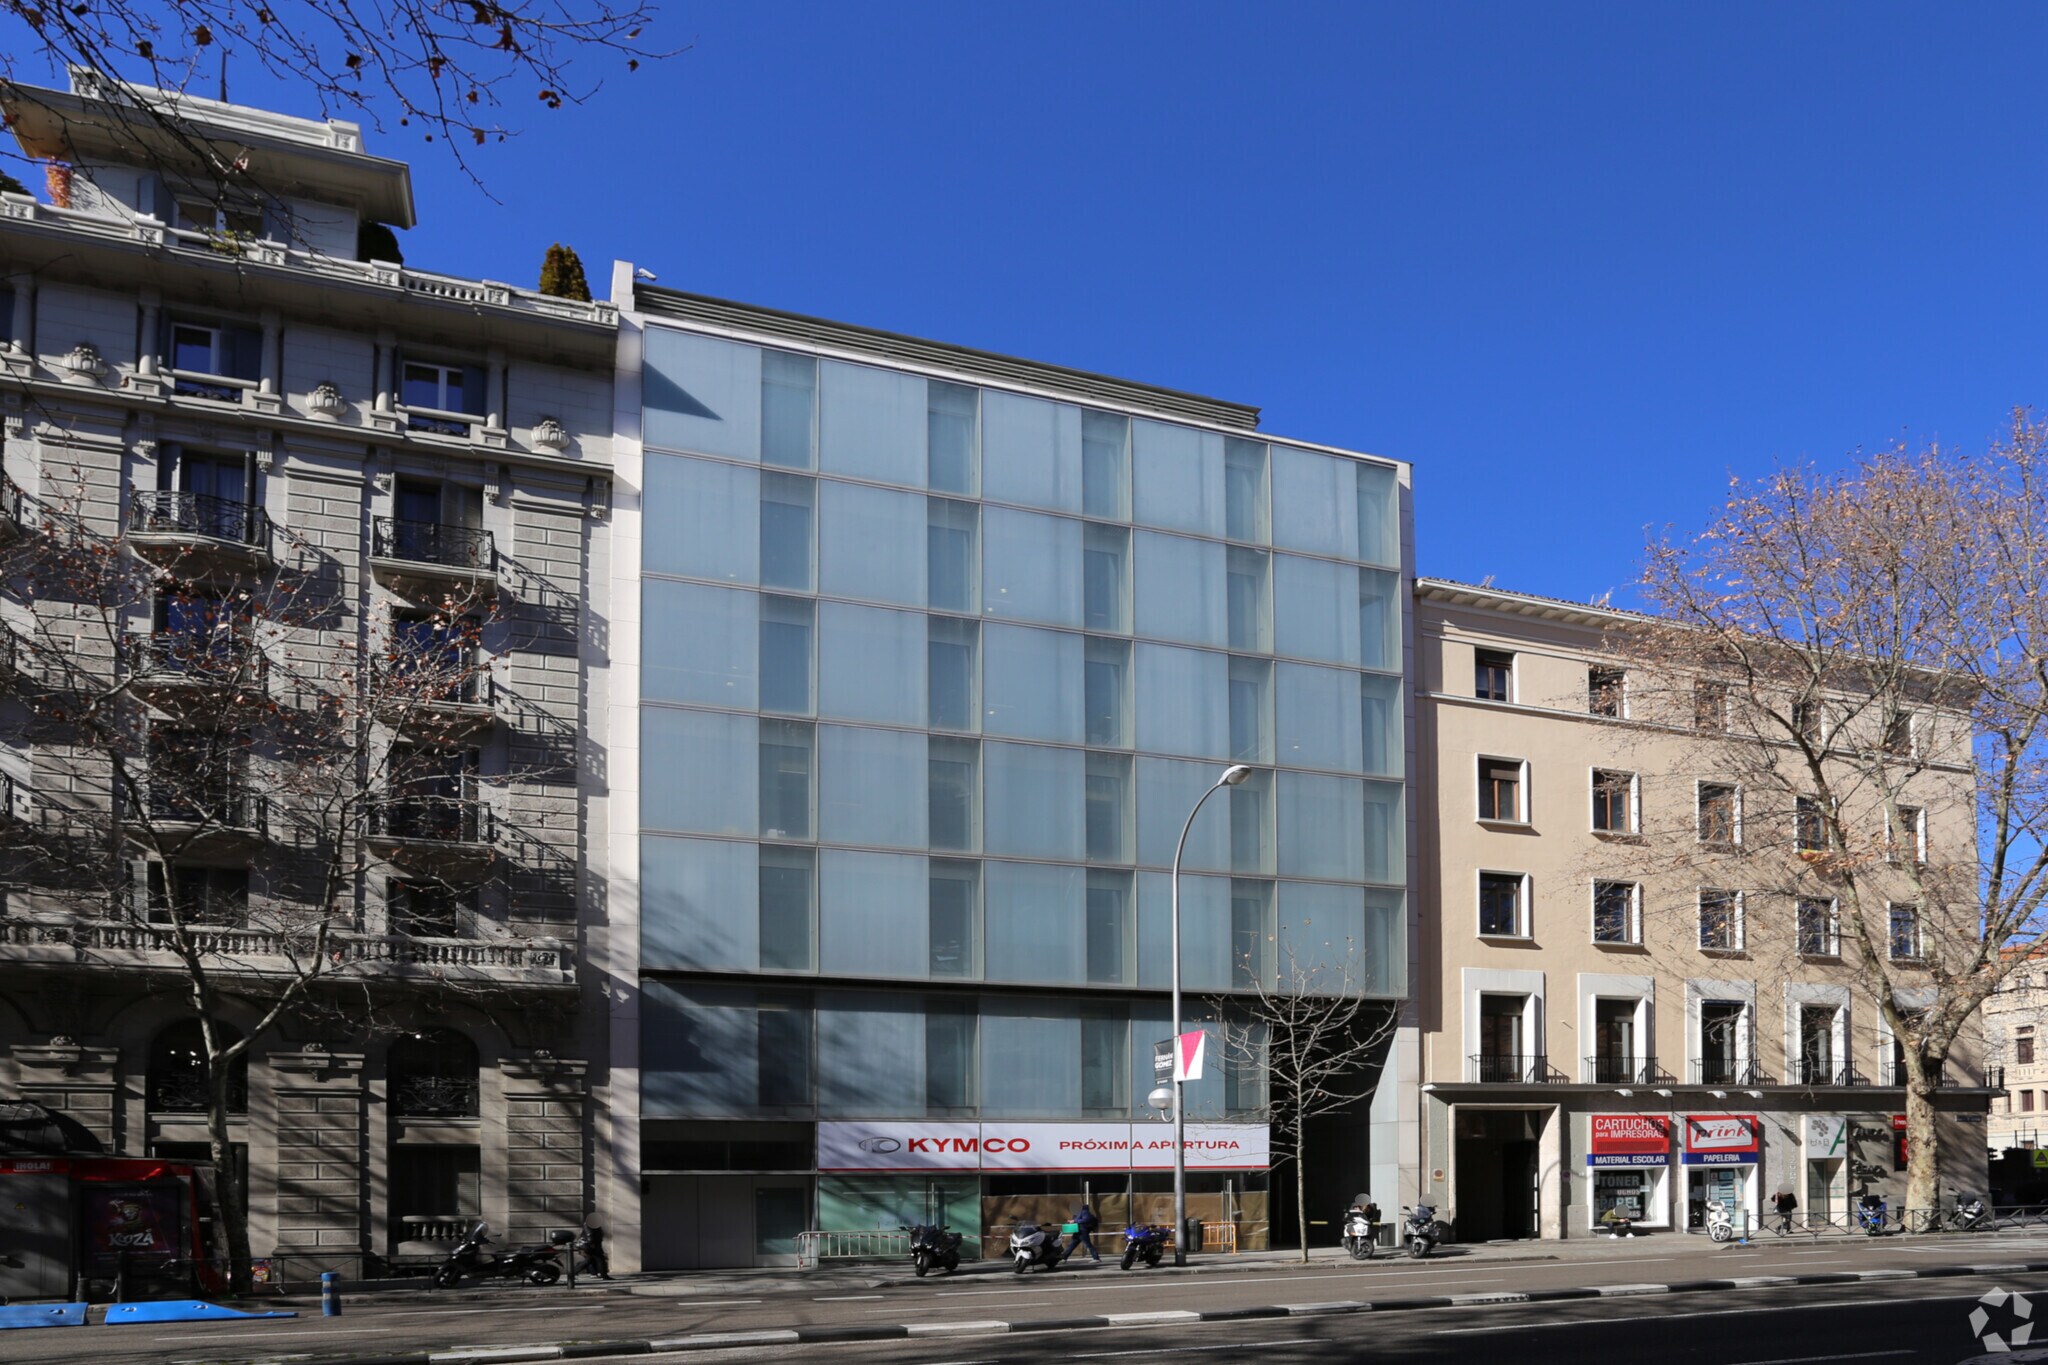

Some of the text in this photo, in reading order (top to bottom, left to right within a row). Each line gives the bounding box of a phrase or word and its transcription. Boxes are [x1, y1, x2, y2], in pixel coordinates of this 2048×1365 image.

[1595, 1118, 1665, 1130] CARTUCHOS
[1610, 1130, 1664, 1138] IMPRESORAS
[1694, 1125, 1747, 1142] prink
[908, 1138, 1031, 1153] KYMCO
[1059, 1139, 1240, 1150] PRÓXIMA APRTURA
[1595, 1155, 1666, 1164] MATERIAL ESCOLAR
[1703, 1153, 1740, 1162] PAPELERIA
[1600, 1196, 1641, 1210] PAPEL
